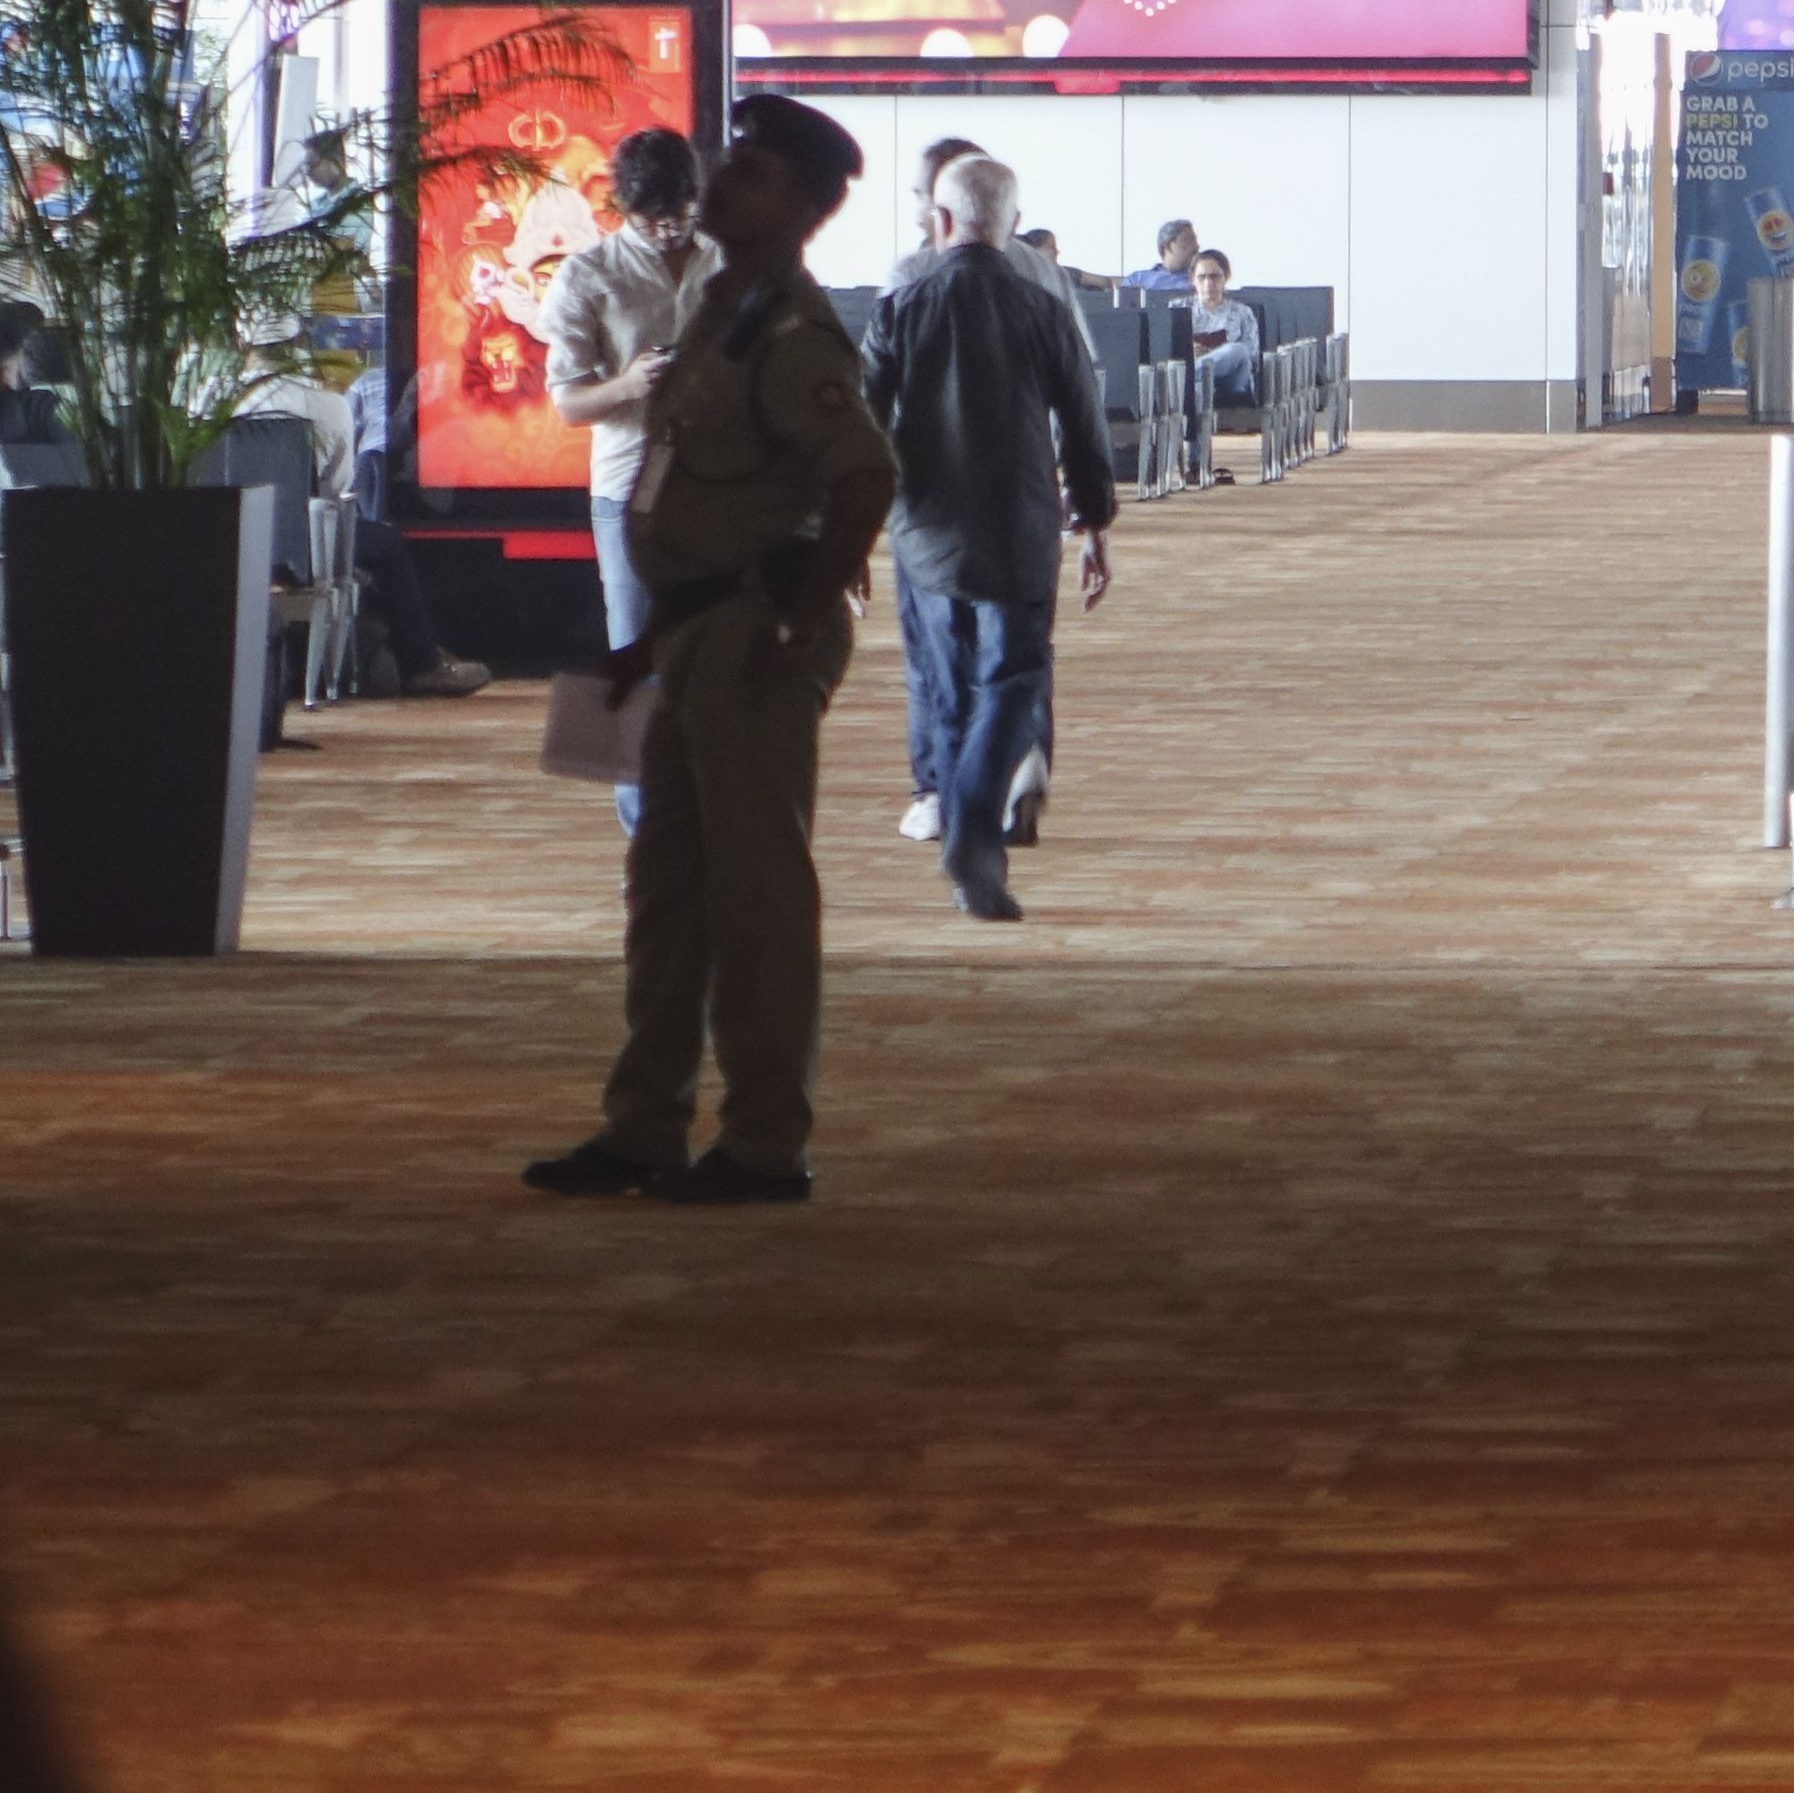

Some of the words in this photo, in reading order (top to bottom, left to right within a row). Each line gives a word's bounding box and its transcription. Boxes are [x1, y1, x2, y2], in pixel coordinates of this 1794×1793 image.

[1728, 57, 1794, 83] pepsi
[1686, 96, 1738, 112] GRAB
[1743, 96, 1756, 112] A
[1686, 113, 1738, 128] PEPSI
[1743, 113, 1769, 129] TO
[1686, 131, 1753, 146] MATCH
[1686, 147, 1738, 163] YOUR
[1686, 164, 1747, 180] MOOD
